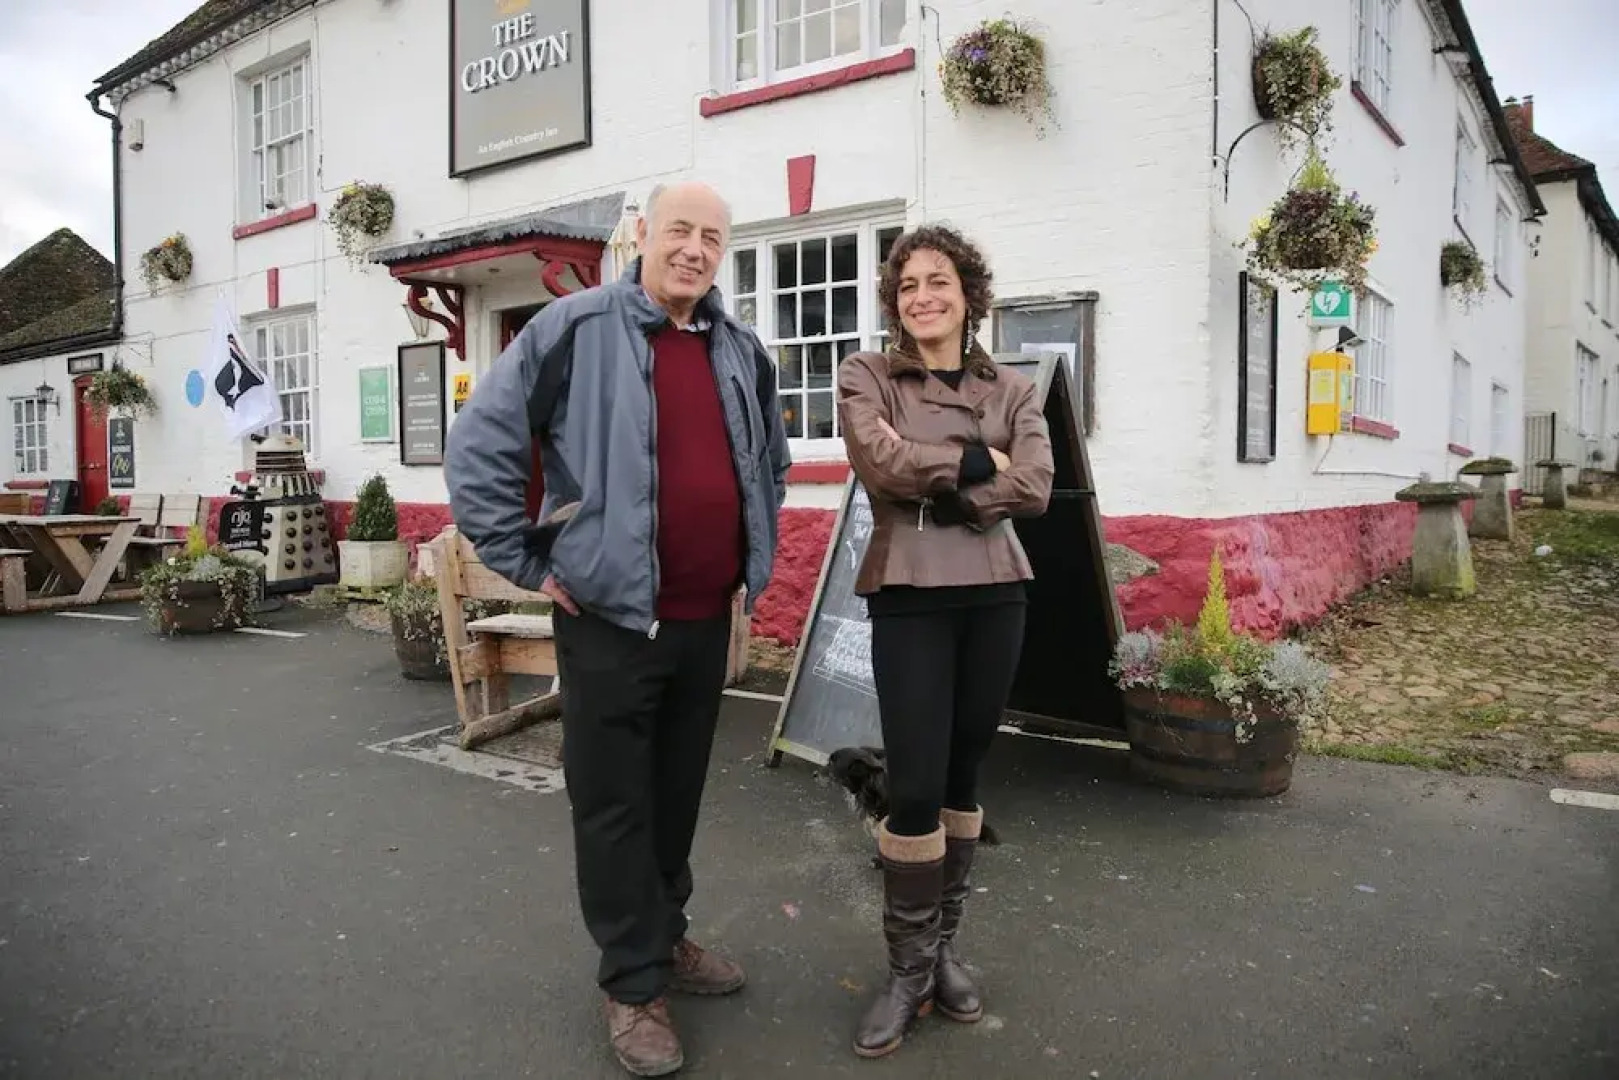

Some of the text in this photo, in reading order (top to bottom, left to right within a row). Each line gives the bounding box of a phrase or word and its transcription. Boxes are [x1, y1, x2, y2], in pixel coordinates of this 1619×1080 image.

[492, 12, 533, 47] THE
[461, 30, 569, 92] CROWN
[514, 130, 545, 145] Country
